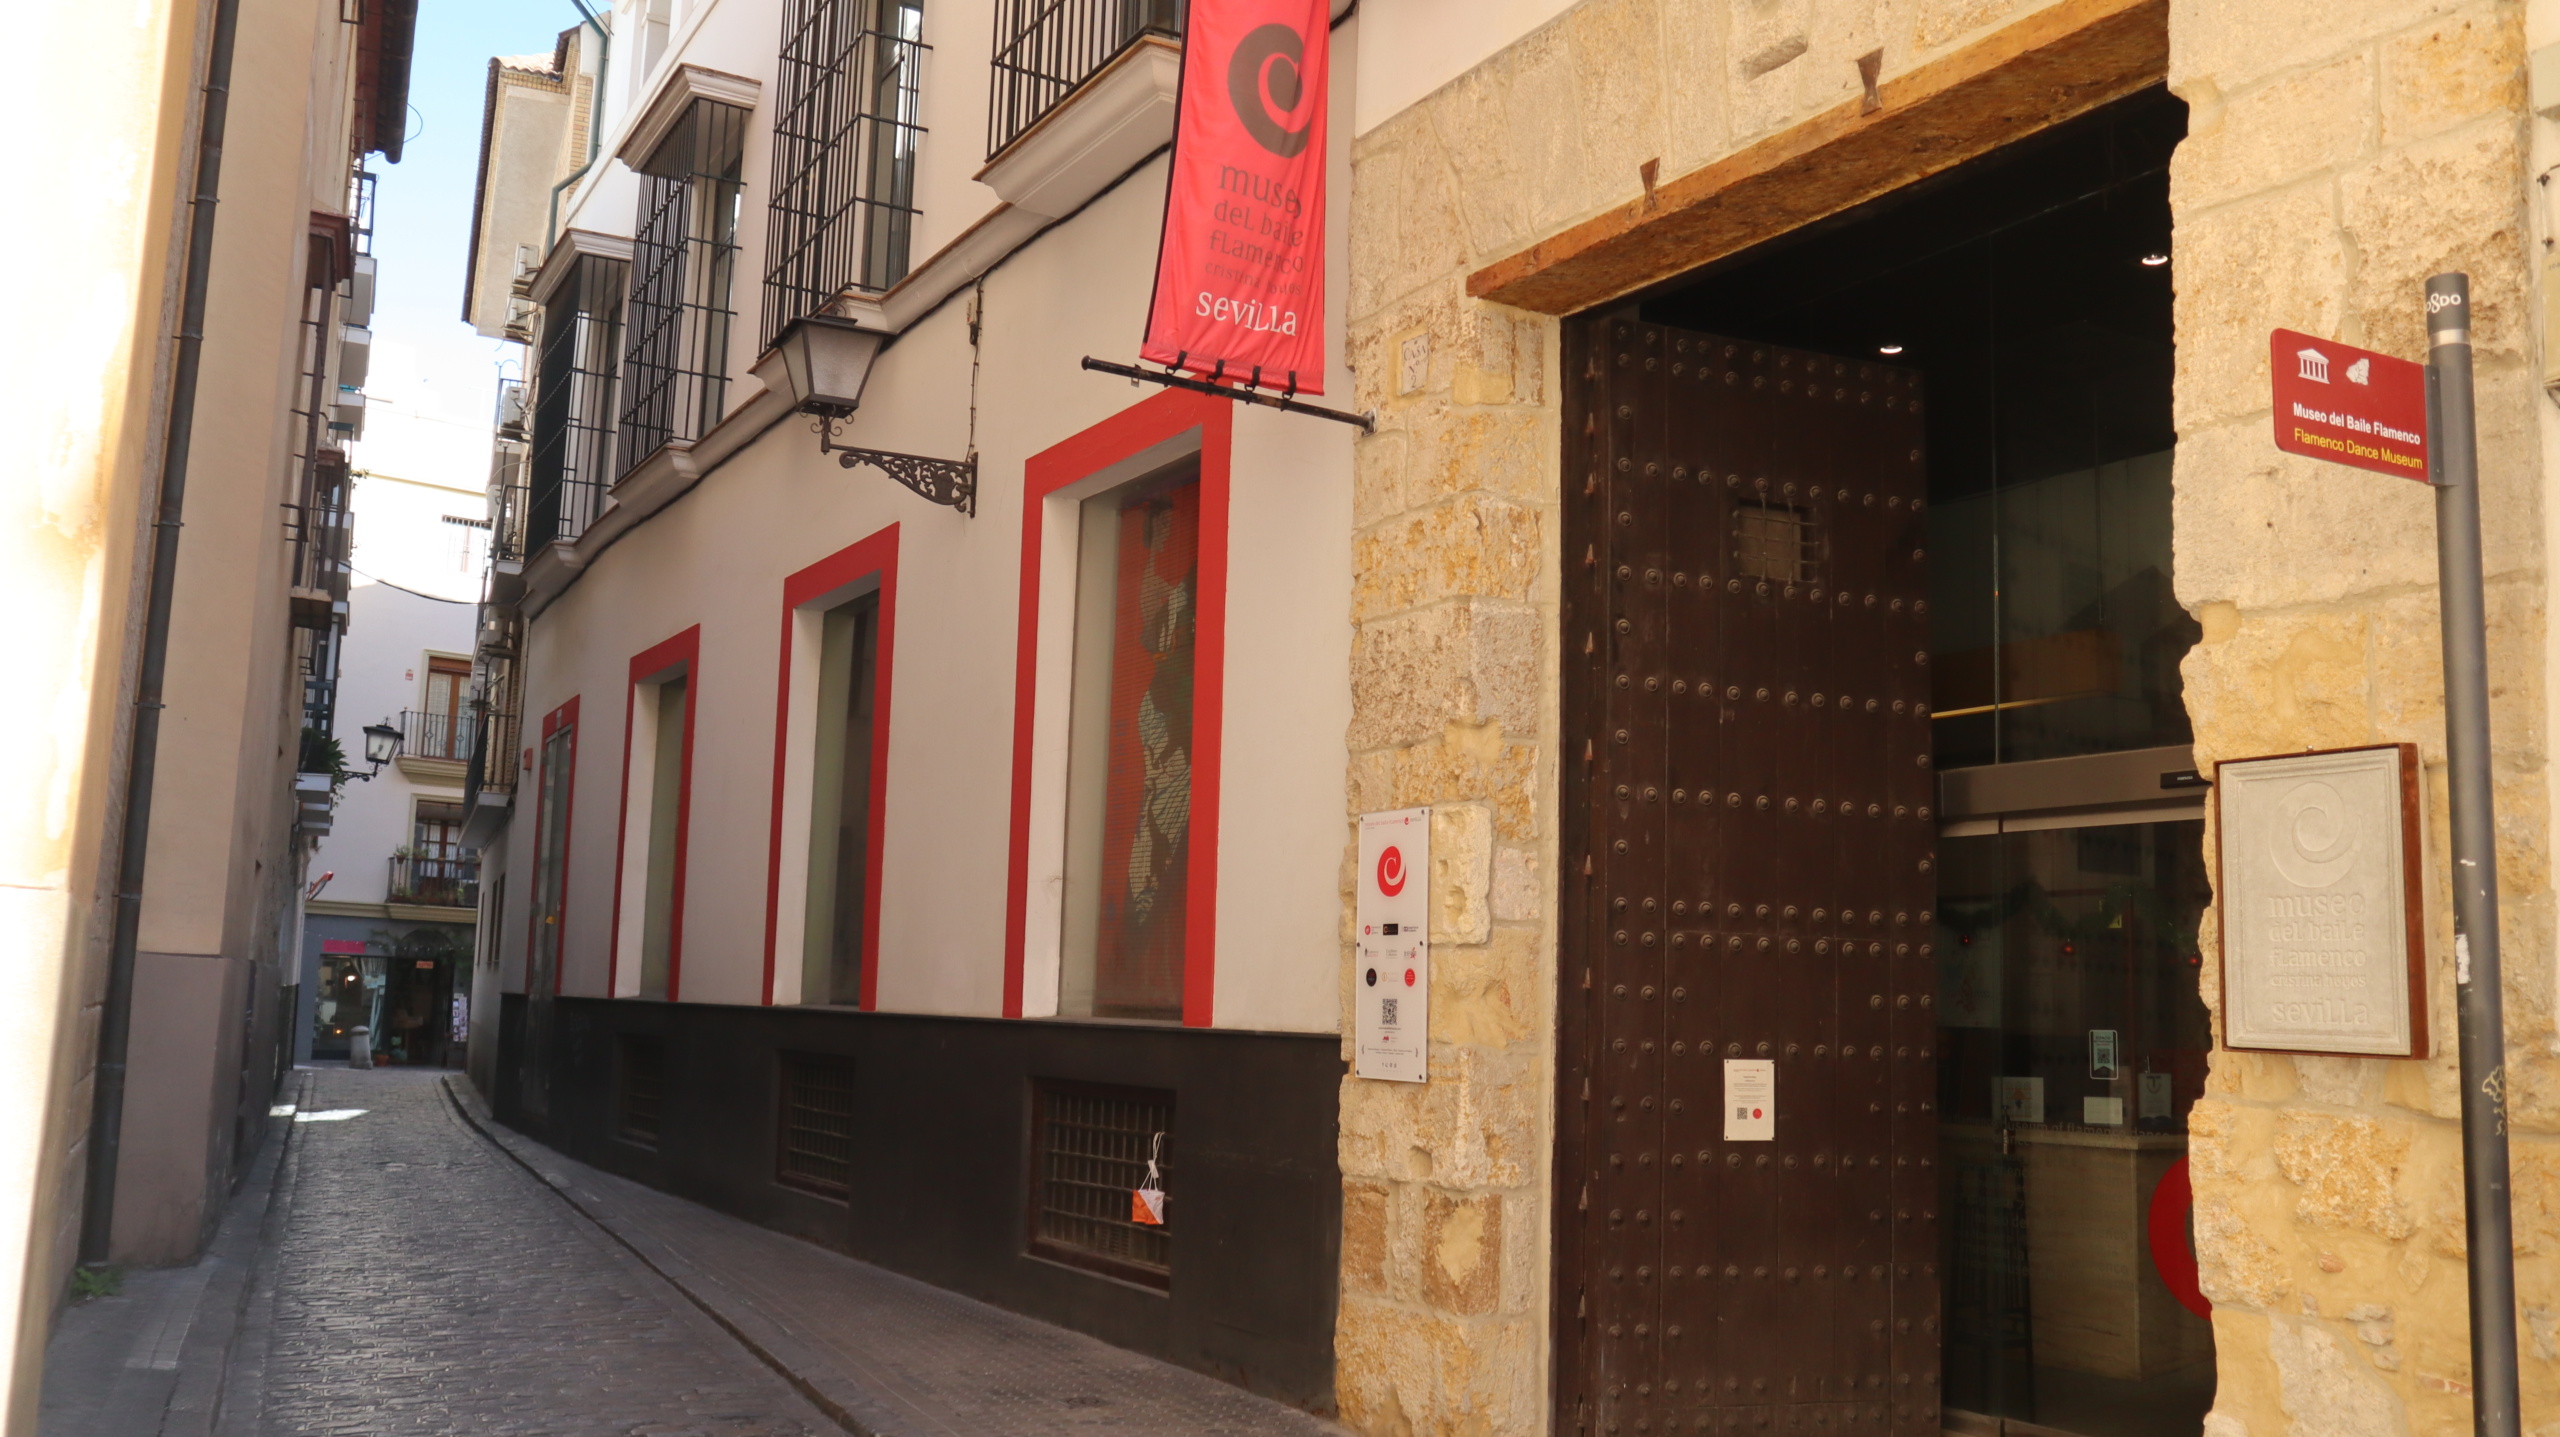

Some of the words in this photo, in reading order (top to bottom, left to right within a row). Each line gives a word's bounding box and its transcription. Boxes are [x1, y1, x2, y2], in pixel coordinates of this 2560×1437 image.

[1411, 375, 1417, 387] 2
[2293, 401, 2327, 423] Museo
[2329, 411, 2345, 428] del
[2346, 415, 2372, 433] Baile
[2373, 421, 2421, 445] Flamenco
[2294, 427, 2345, 452] Flamenco
[2346, 440, 2379, 460] Dance
[2381, 447, 2423, 469] Museum
[2268, 892, 2365, 918] museo
[2271, 972, 2322, 988] cristina
